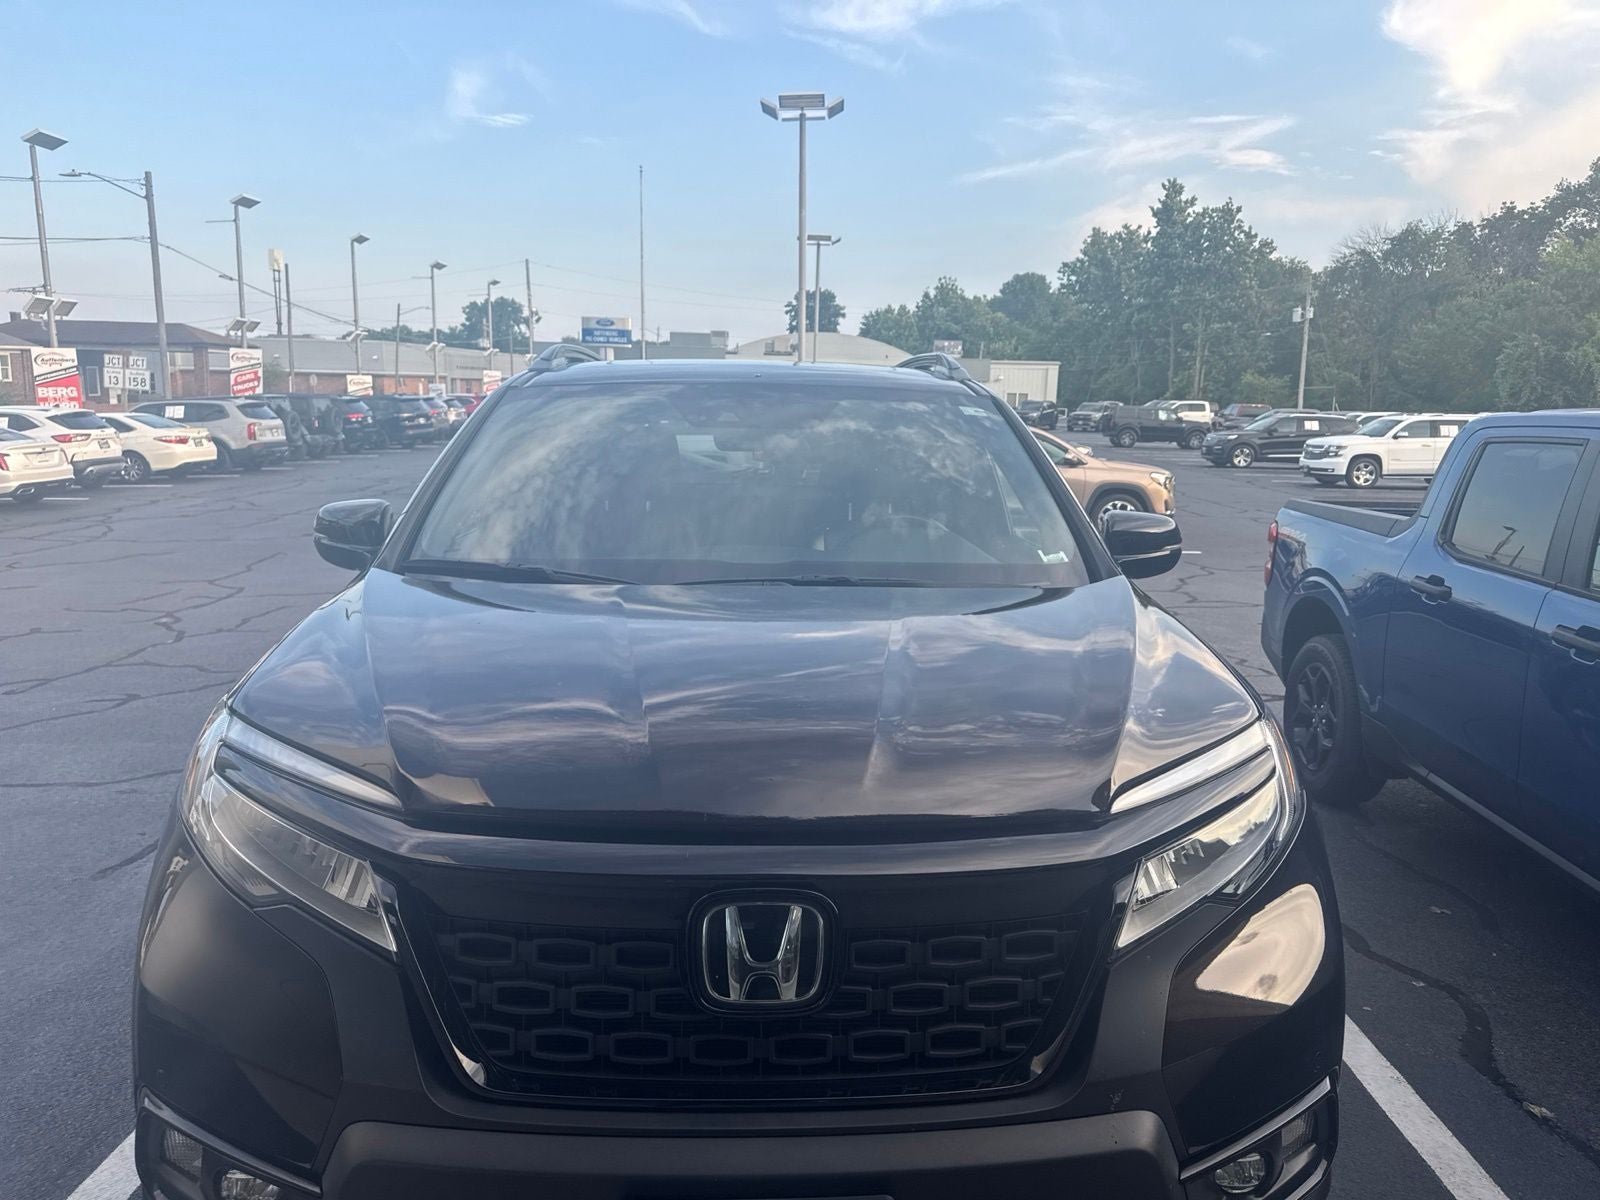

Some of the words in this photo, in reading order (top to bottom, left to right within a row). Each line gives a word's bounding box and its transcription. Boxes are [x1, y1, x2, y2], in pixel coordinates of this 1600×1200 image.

[106, 356, 121, 366] JCT
[130, 358, 145, 367] JCT
[108, 375, 119, 385] 13
[128, 376, 147, 387] 158
[38, 386, 78, 398] BERG
